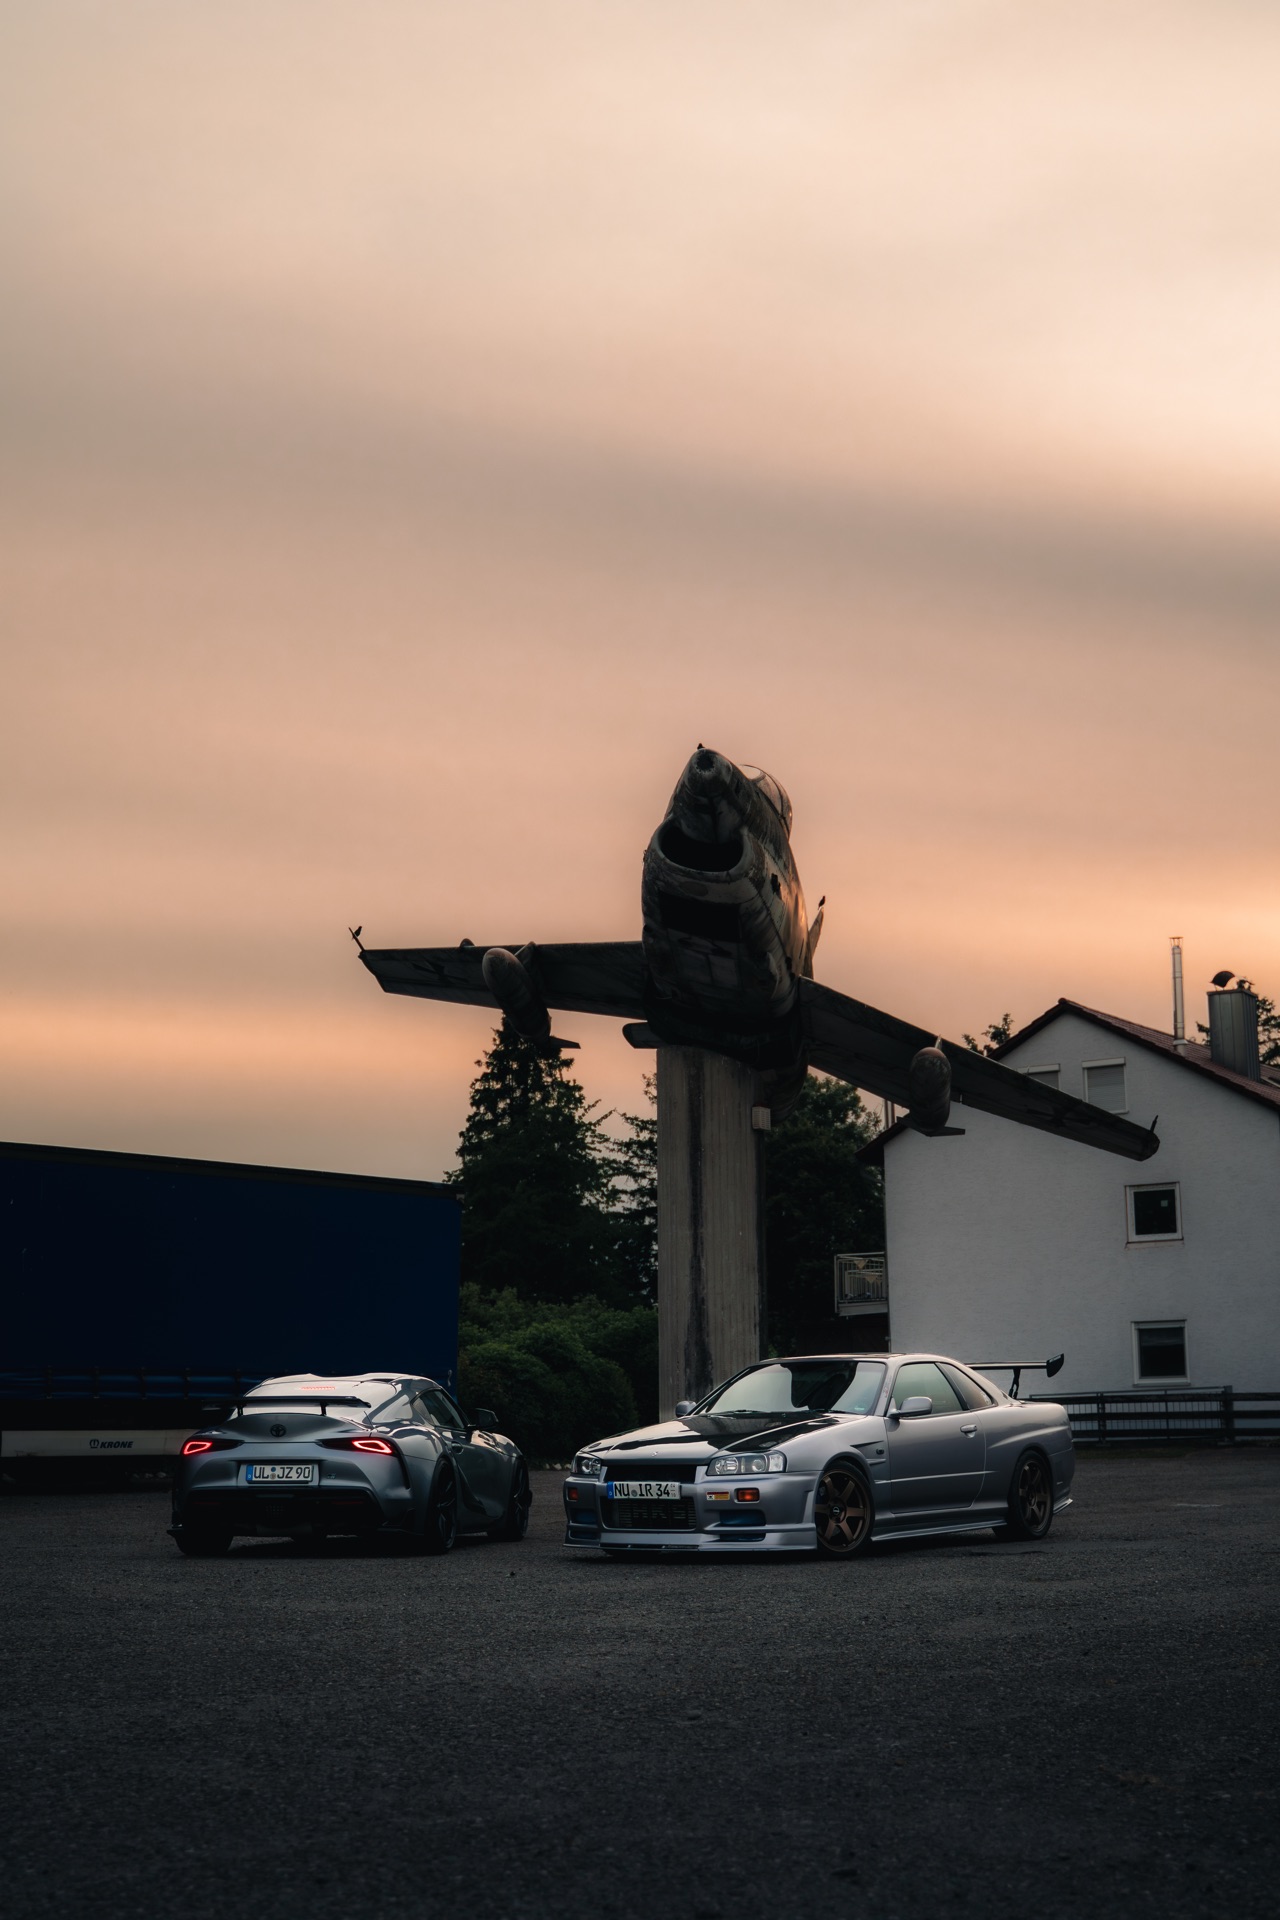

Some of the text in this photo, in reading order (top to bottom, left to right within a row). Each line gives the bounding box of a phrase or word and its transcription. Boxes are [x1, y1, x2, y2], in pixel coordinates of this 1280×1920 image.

[253, 1466, 270, 1479] UL
[277, 1466, 294, 1479] JZ
[296, 1466, 311, 1479] 90
[614, 1483, 670, 1497] NU IR 34
